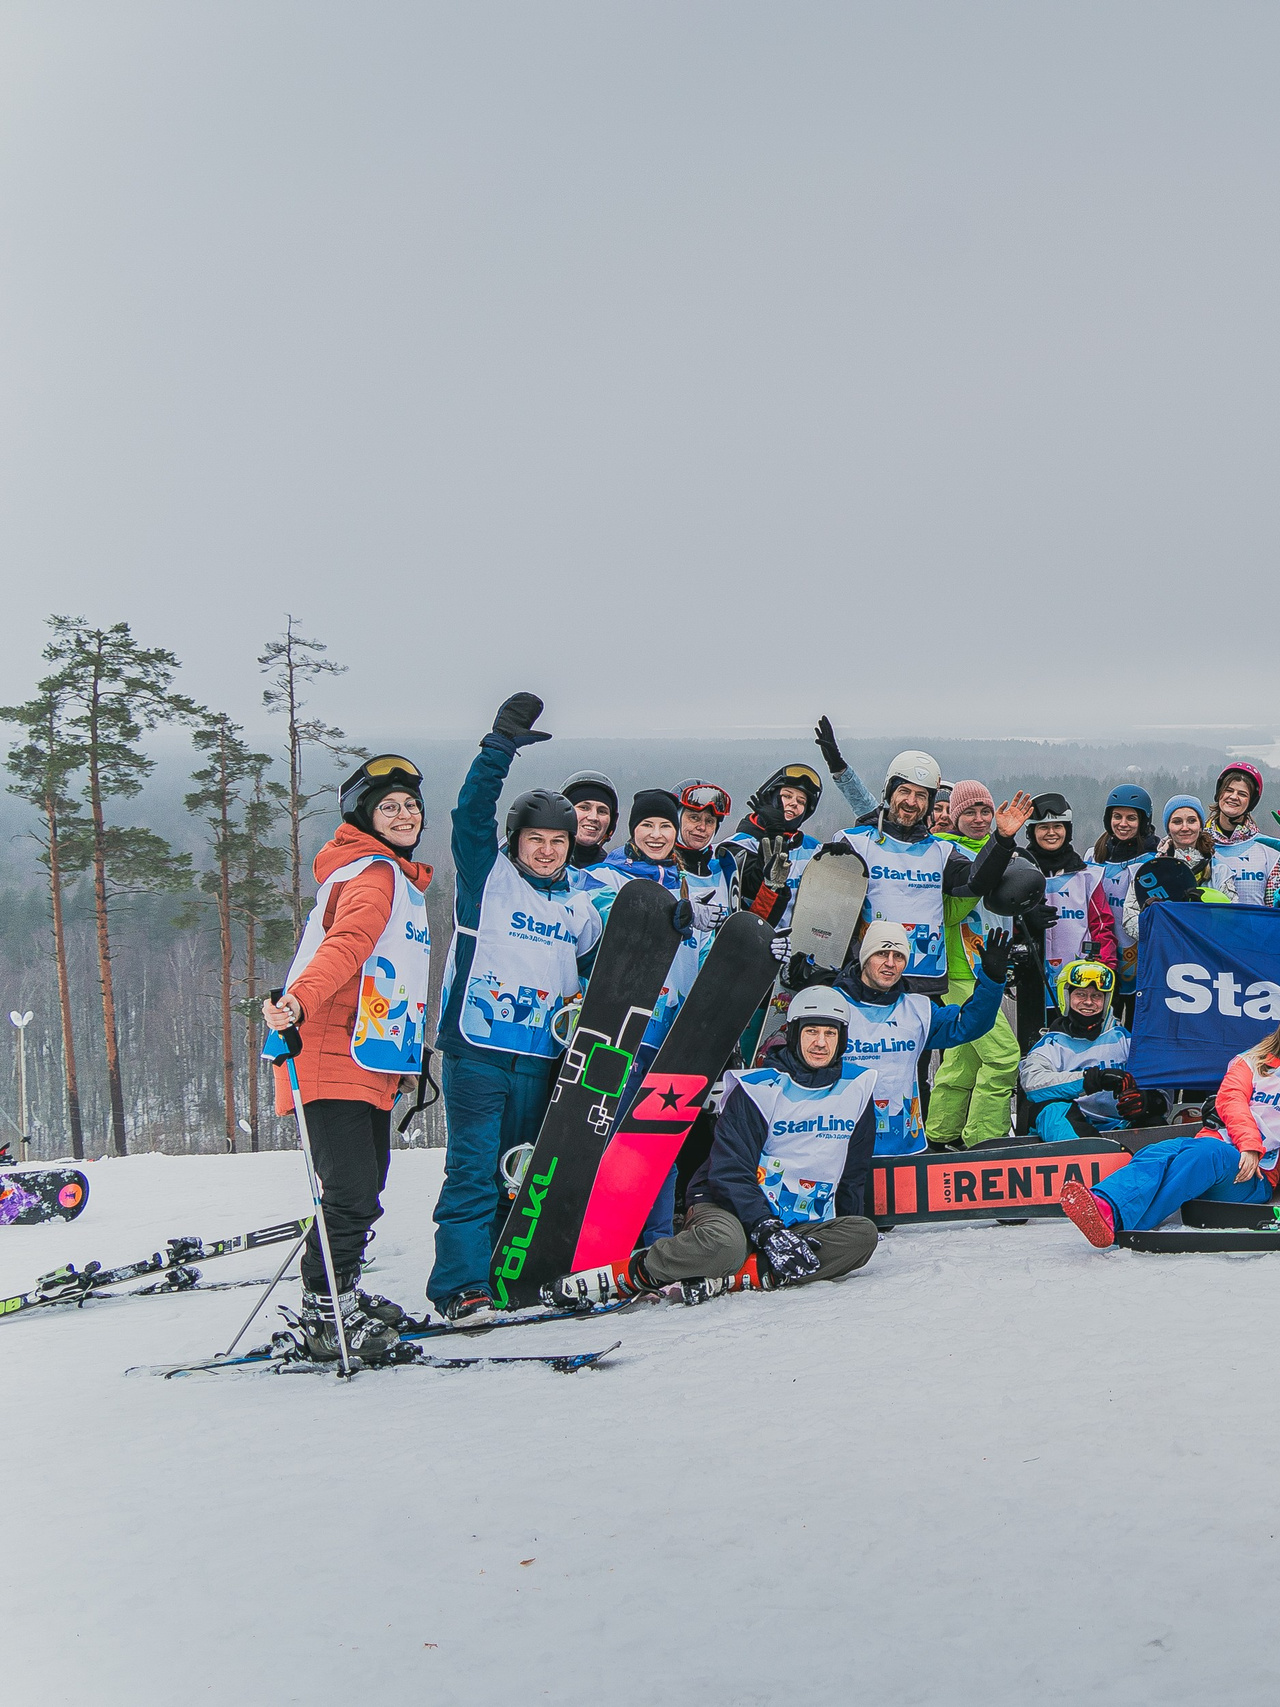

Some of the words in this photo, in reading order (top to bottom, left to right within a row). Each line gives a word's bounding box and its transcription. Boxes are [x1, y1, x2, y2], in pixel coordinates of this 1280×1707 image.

[871, 865, 941, 882] StarLine
[846, 1038, 916, 1053] StarLine
[773, 1115, 855, 1136] StarLine
[943, 1171, 951, 1203] JOINT
